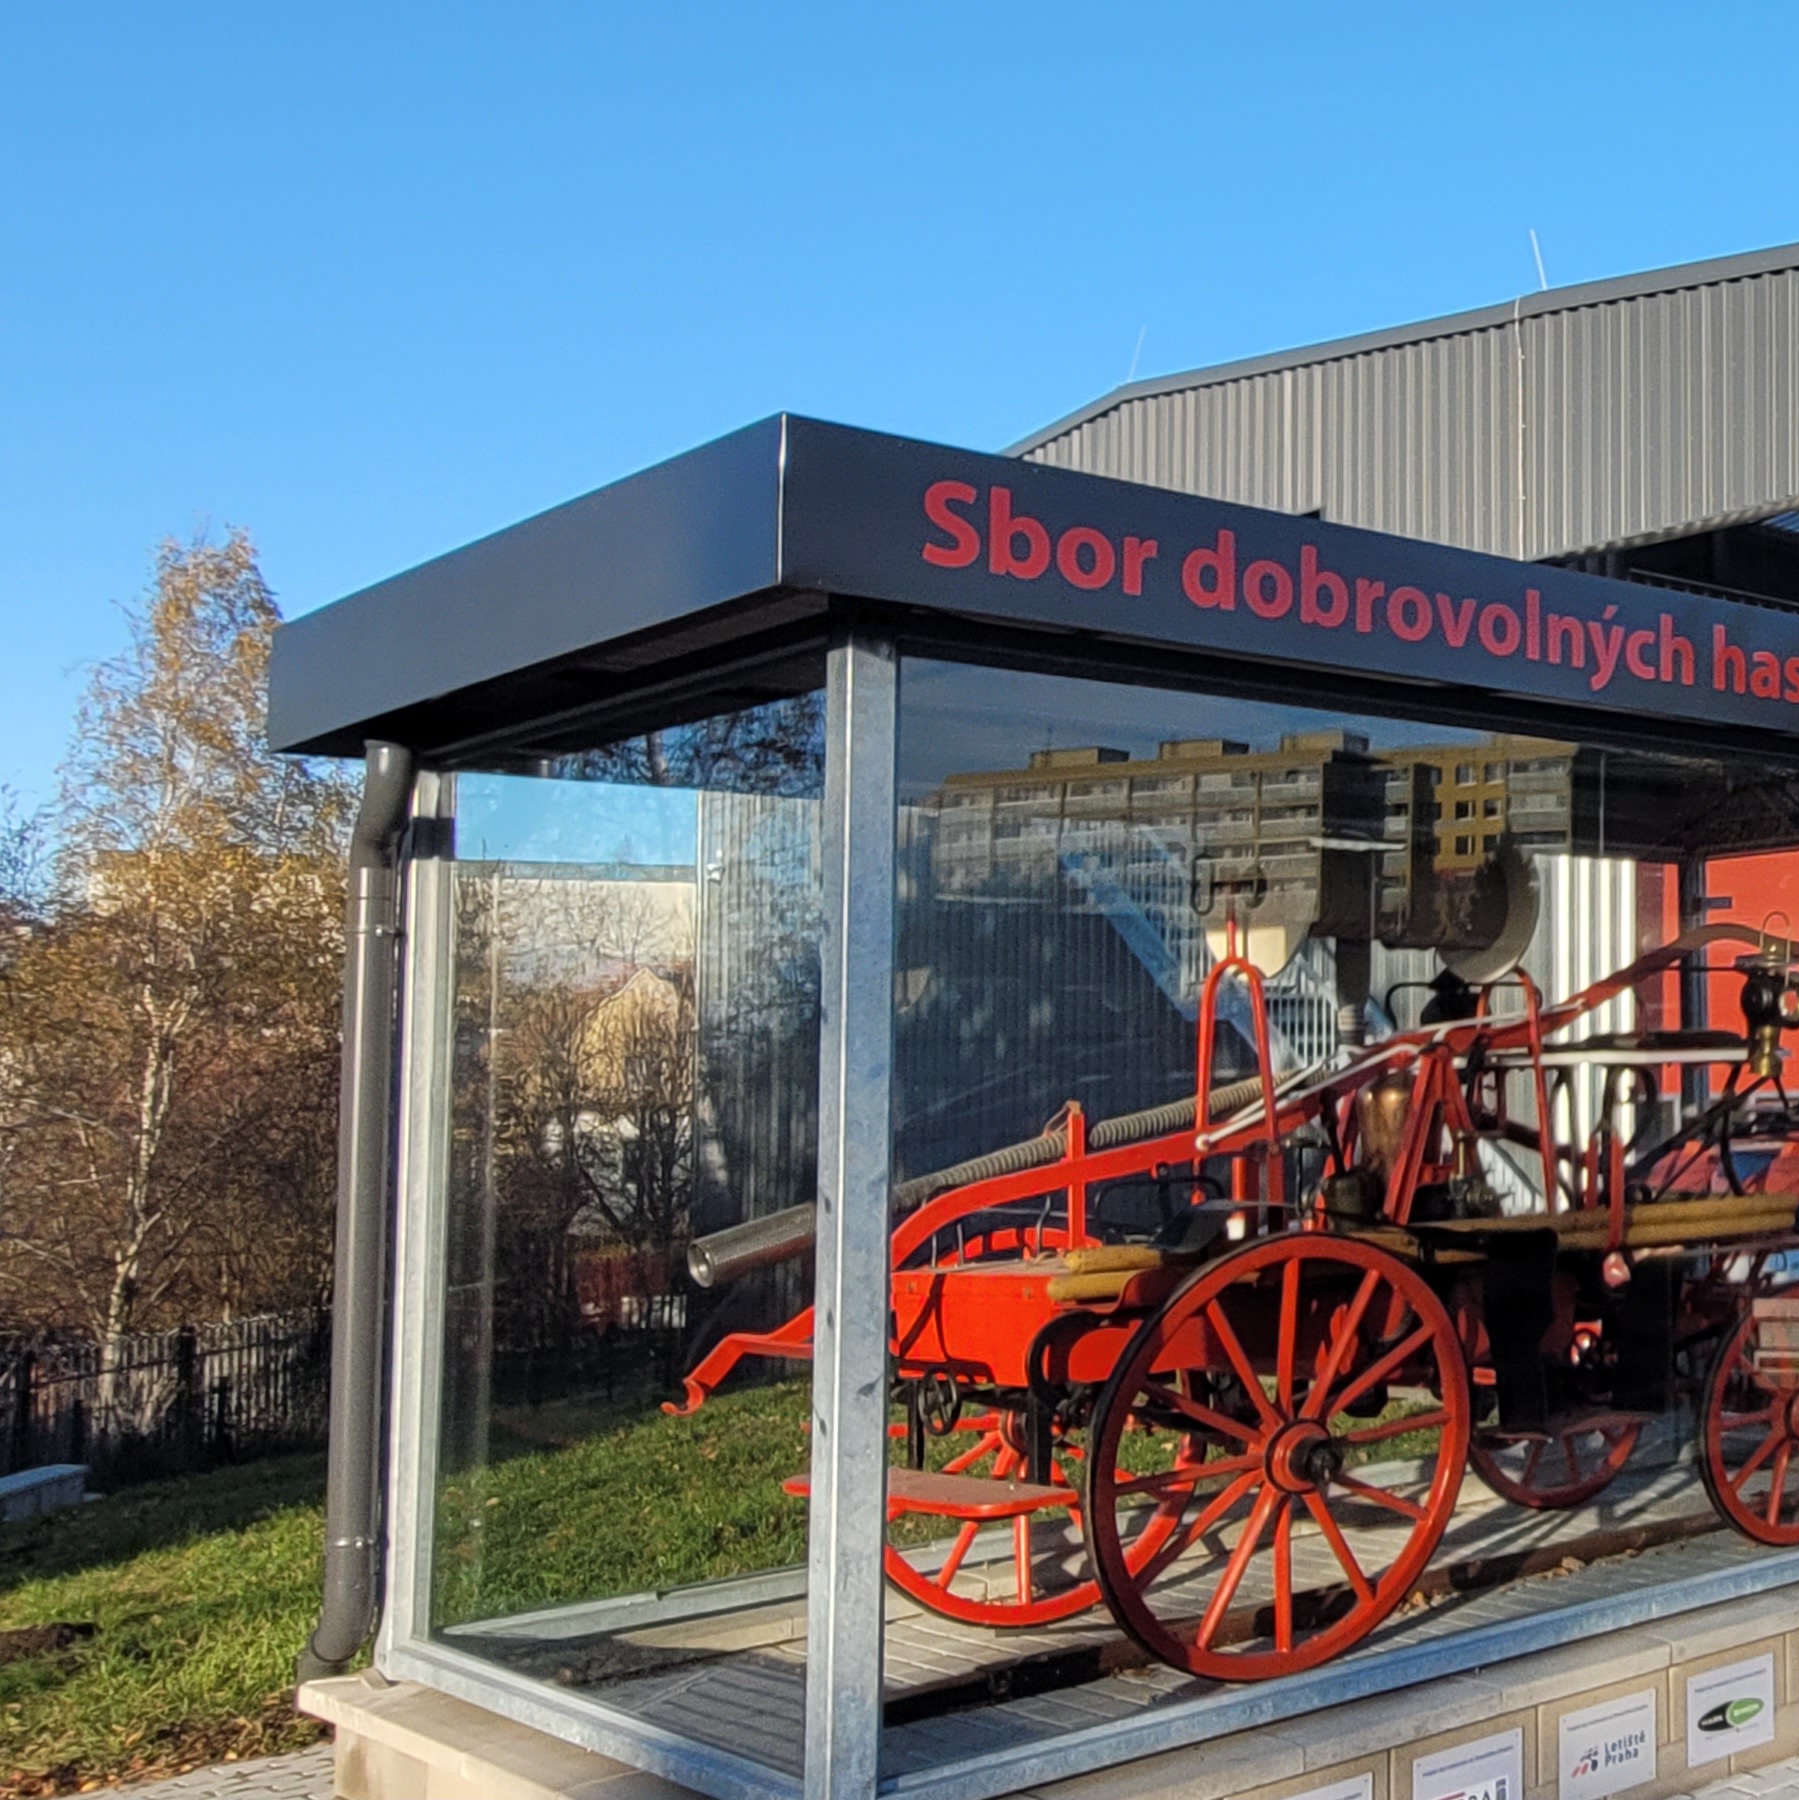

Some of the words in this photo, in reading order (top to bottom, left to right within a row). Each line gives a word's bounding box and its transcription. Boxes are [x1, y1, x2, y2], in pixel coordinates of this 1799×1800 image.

[922, 480, 1159, 596] Sbor
[1182, 529, 1696, 690] dobrovolných
[1604, 1748, 1639, 1767] Praha
